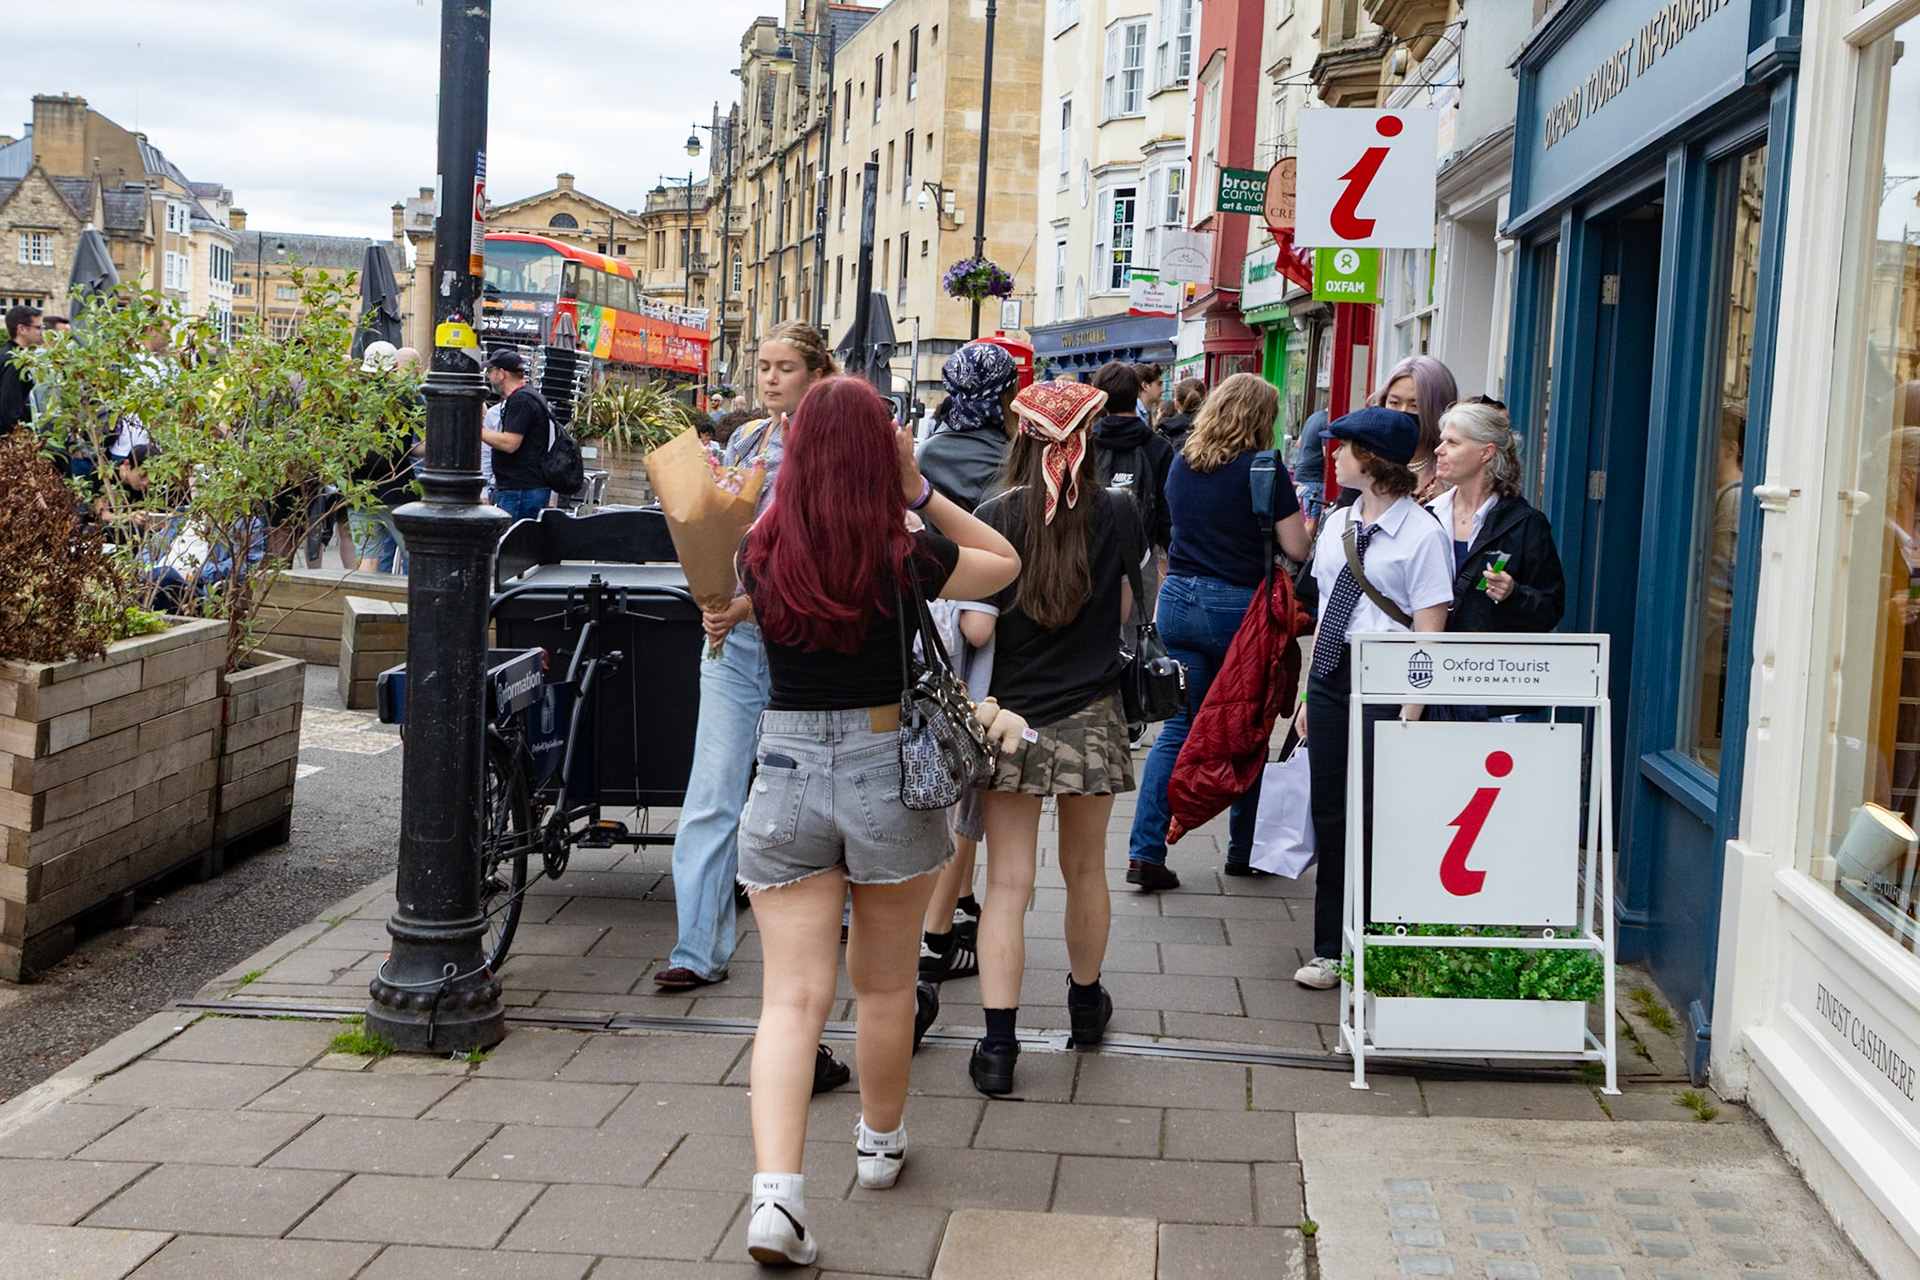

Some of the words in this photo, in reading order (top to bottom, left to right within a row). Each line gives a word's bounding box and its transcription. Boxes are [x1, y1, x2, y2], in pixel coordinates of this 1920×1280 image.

[1544, 86, 1582, 150] OXFORD
[1586, 38, 1634, 118] TOURIST
[1637, 0, 1729, 77] INFORMA
[1330, 115, 1403, 240] i
[1221, 189, 1263, 202] canva
[1222, 202, 1234, 210] art
[1236, 203, 1242, 211] &
[1325, 280, 1365, 293] OXFAM
[1113, 473, 1134, 482] NIKE
[1443, 658, 1494, 672] Oxford
[1498, 658, 1550, 673] Tourist
[1453, 676, 1540, 684] INFORMATION
[1439, 750, 1514, 897] i
[1816, 983, 1851, 1038] FINEST
[1851, 1017, 1916, 1101] CASHMERE
[874, 1139, 889, 1147] NIKE
[763, 1182, 780, 1190] NIKE
